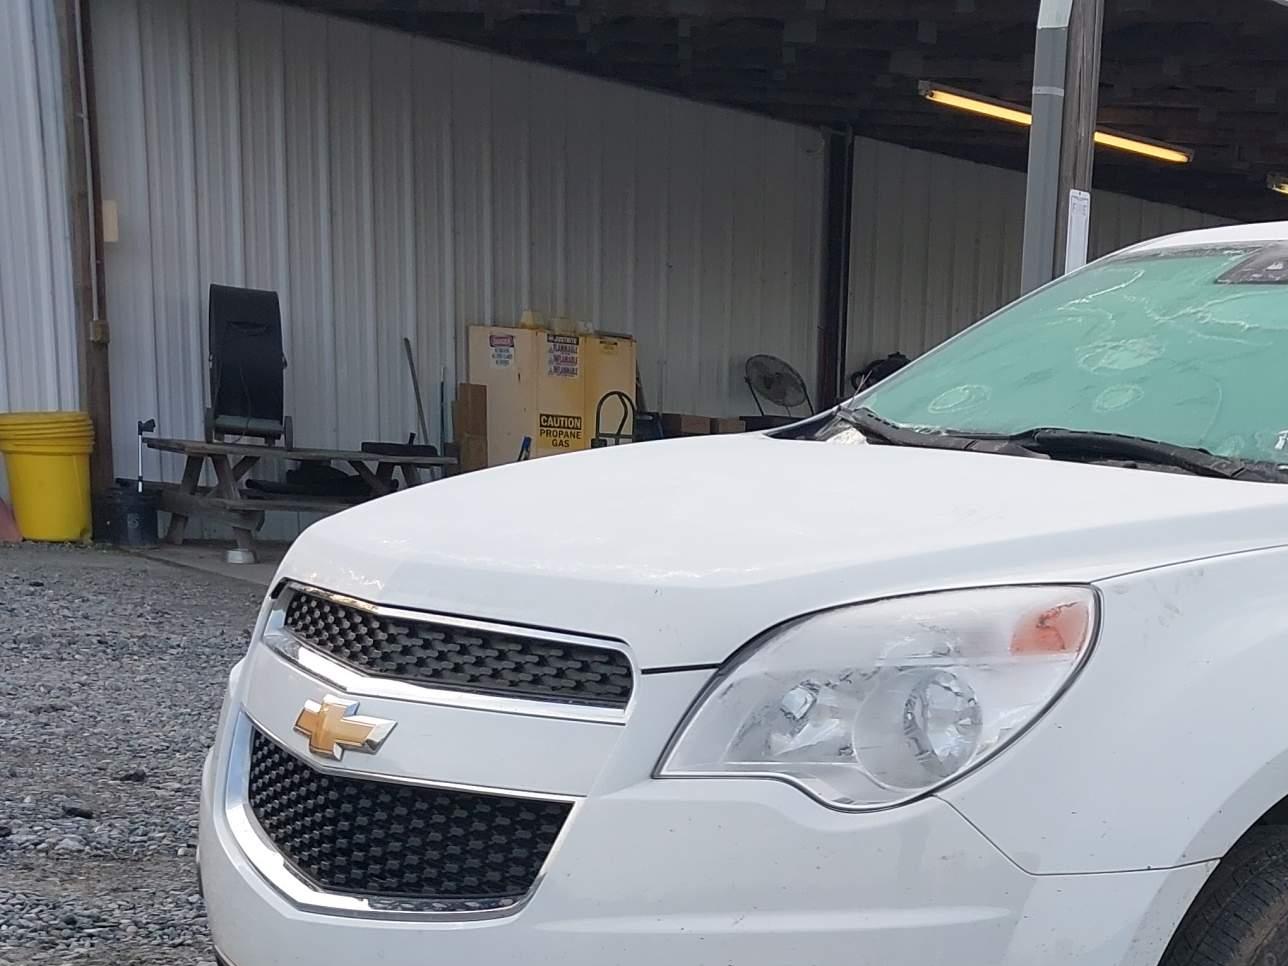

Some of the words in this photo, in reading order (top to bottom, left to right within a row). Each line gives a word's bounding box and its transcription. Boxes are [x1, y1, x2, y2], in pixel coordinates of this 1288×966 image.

[540, 415, 581, 429] CAUTION
[540, 429, 582, 439] PROPANE
[552, 439, 570, 448] GAS
